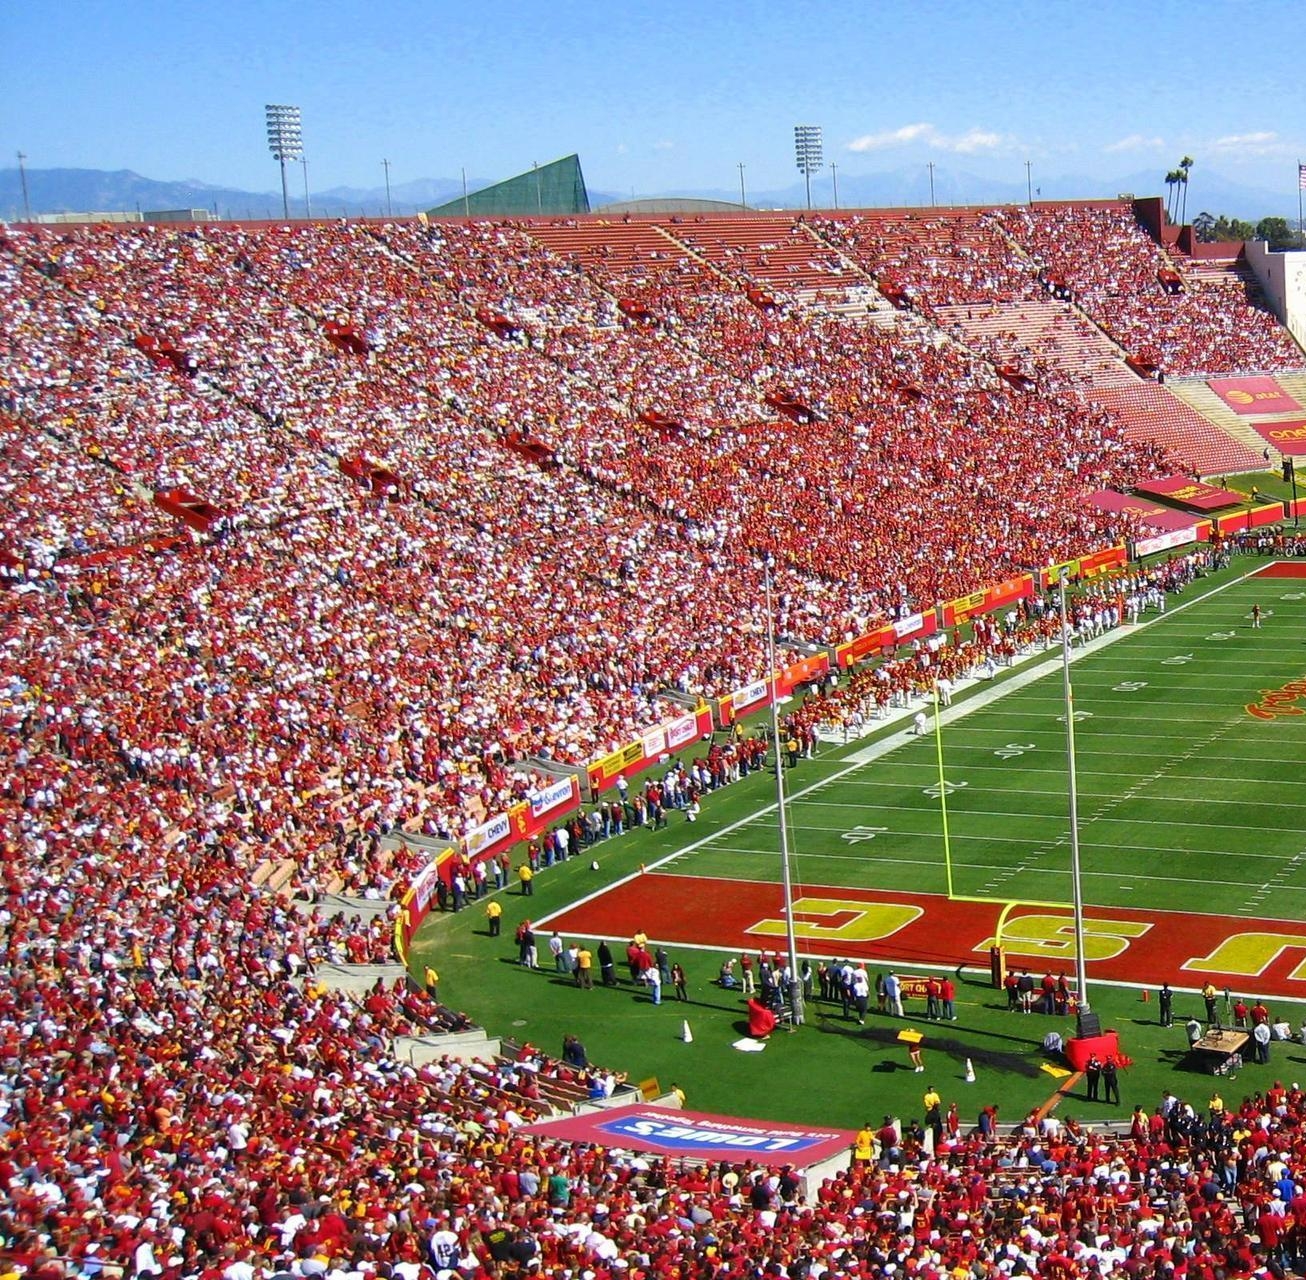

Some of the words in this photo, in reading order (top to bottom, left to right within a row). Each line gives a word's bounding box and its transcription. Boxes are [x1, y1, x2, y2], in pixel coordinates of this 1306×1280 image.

[993, 743, 1035, 756] 30
[923, 780, 968, 794] 20
[487, 819, 508, 839] CHEVY
[841, 826, 888, 841] 10
